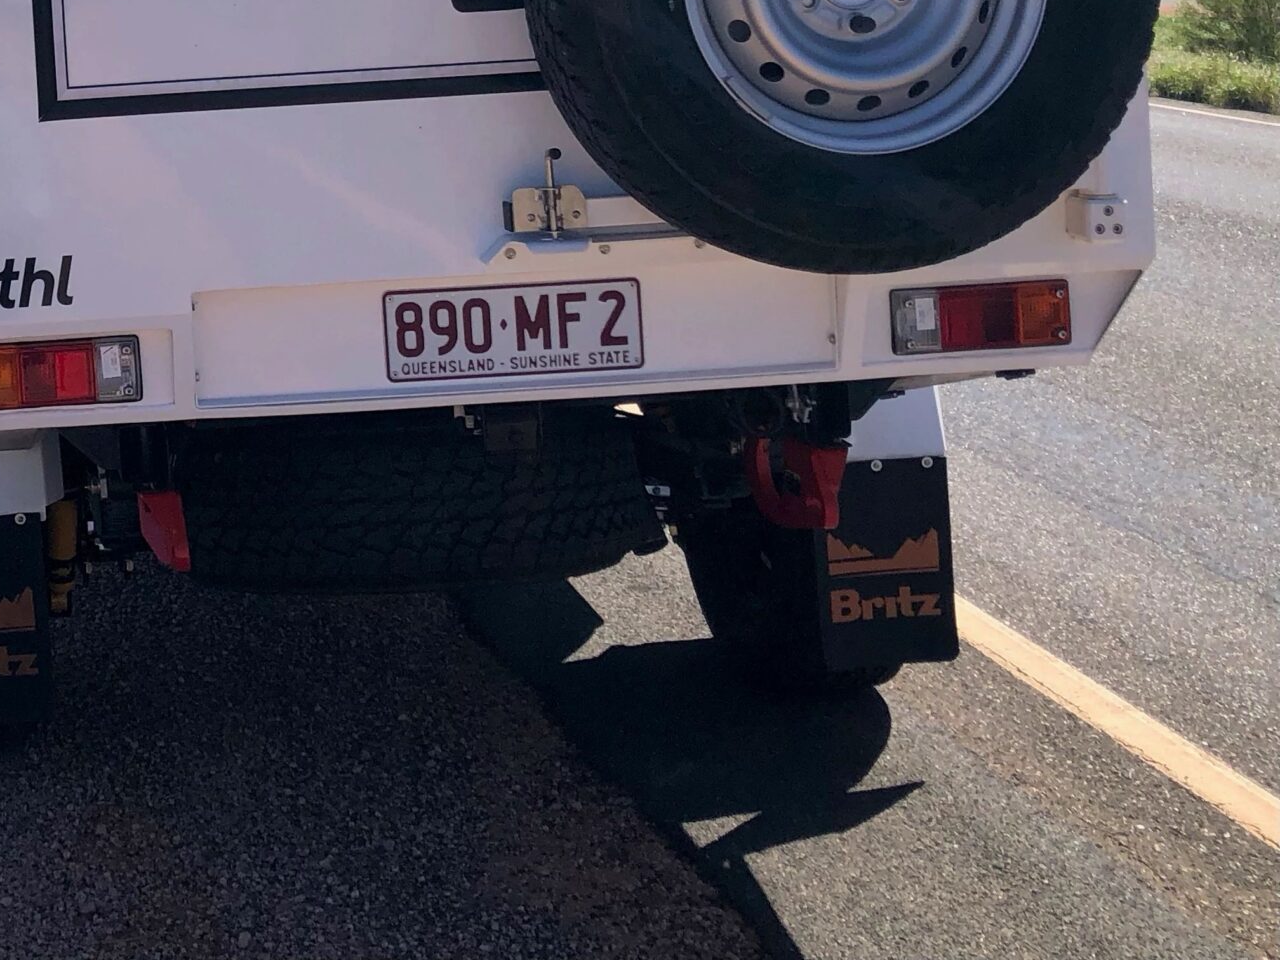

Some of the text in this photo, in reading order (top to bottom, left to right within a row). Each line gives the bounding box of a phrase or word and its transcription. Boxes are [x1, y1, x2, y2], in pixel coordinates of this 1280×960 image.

[401, 358, 495, 375] QUEENSLAND
[510, 353, 580, 369] SUNSHINE
[588, 350, 631, 365] STATE
[830, 586, 942, 623] Britz
